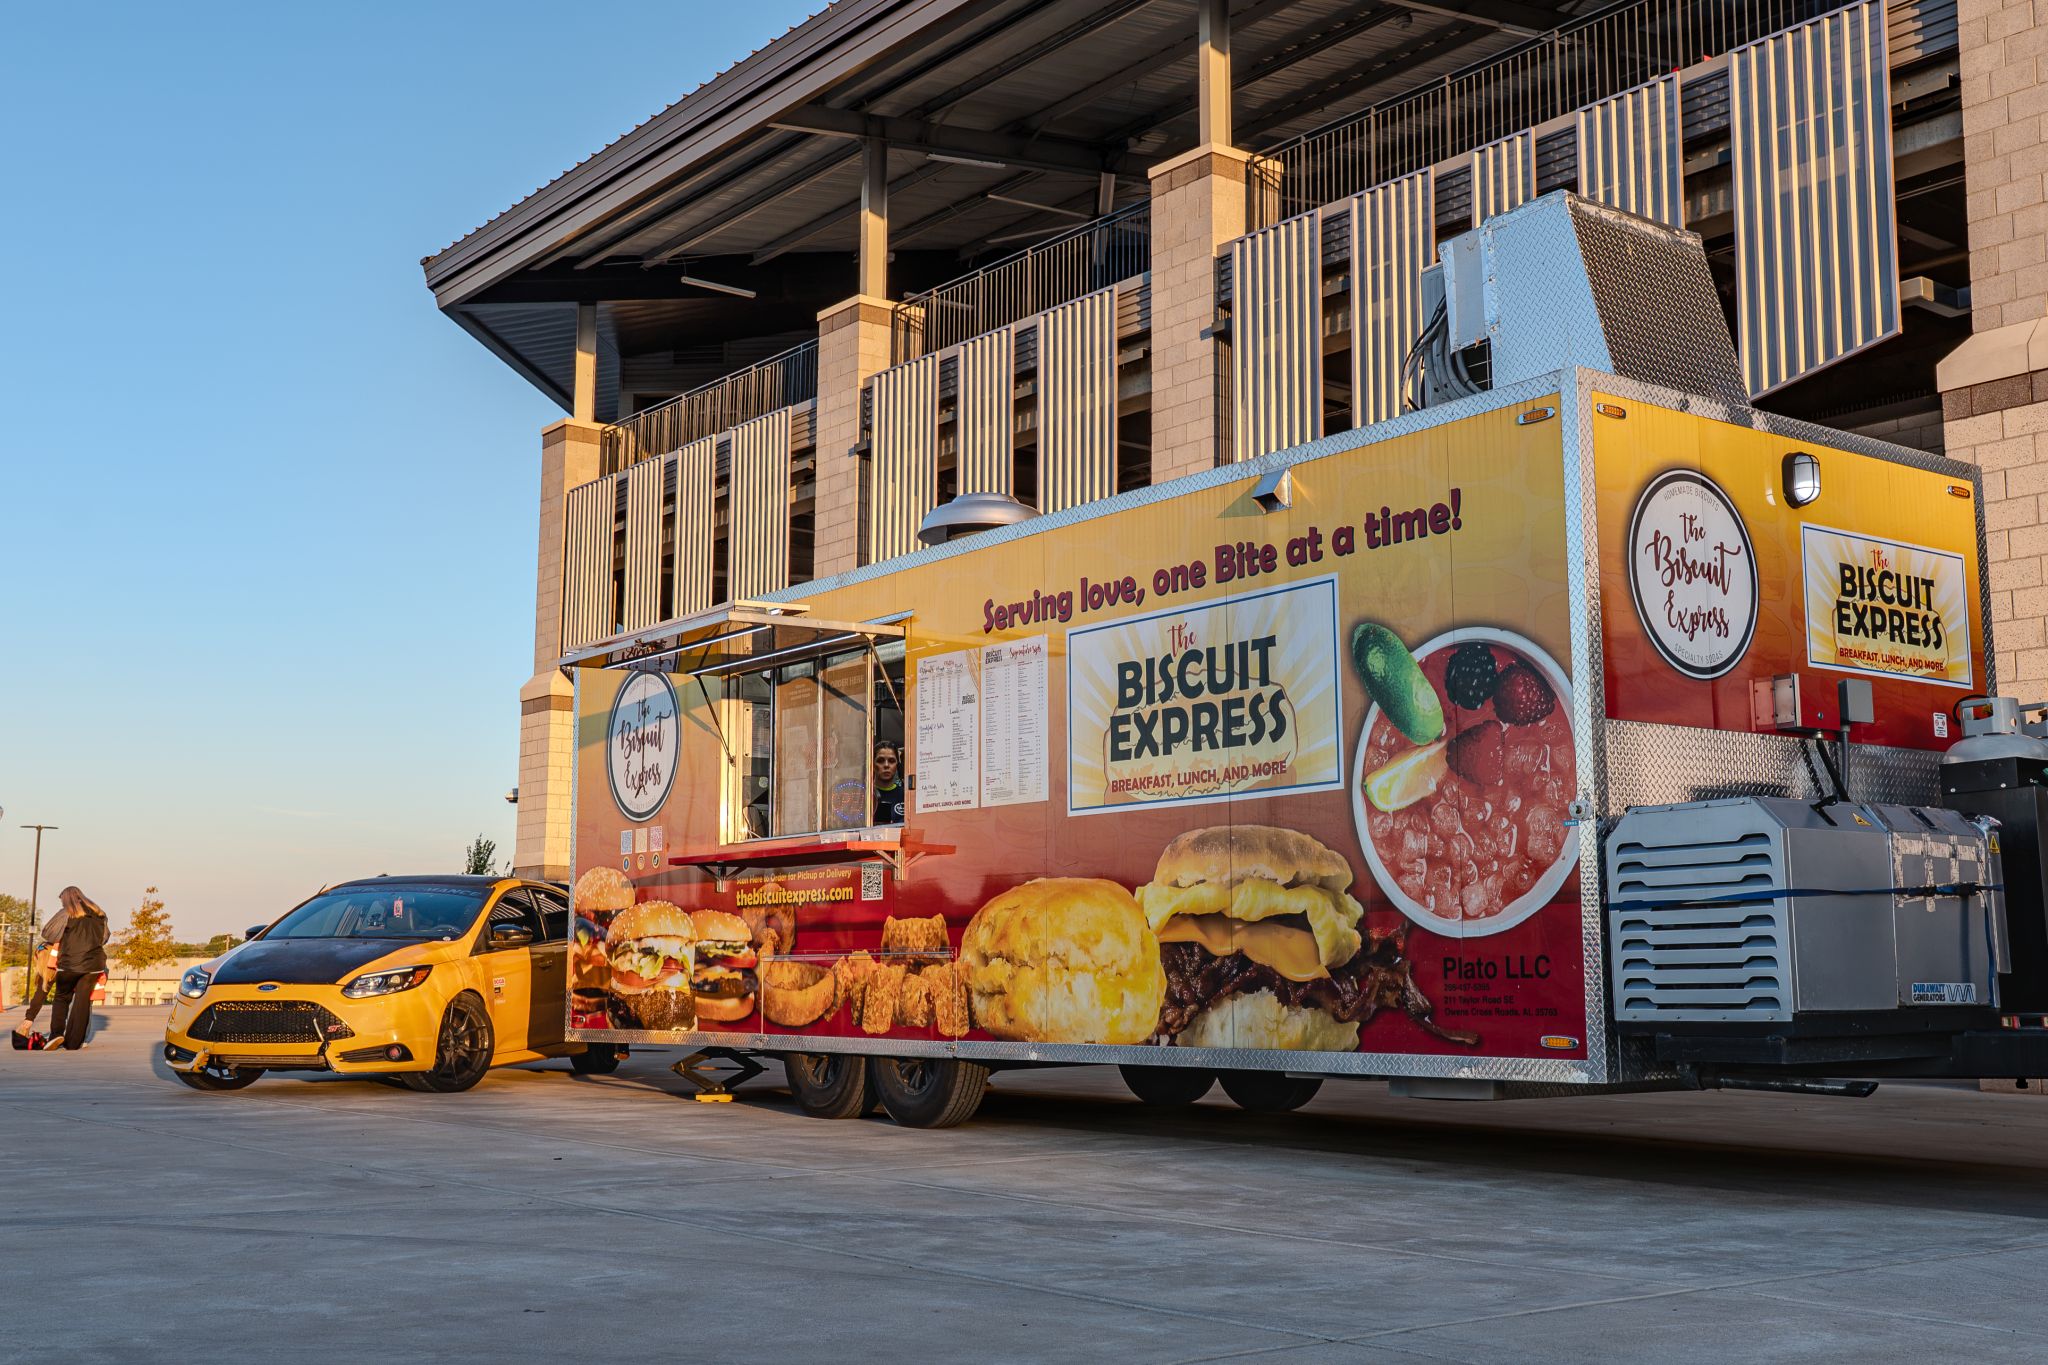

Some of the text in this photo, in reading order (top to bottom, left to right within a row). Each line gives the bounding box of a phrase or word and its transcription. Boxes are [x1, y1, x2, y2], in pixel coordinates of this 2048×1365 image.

[1663, 485, 1720, 512] HOMEMADE BISCUITS
[1679, 512, 1706, 544] the
[983, 488, 1462, 634] Serving love, one Bite at a time!
[1645, 529, 1741, 596] Biscuit
[1870, 549, 1889, 572] the
[1839, 562, 1935, 611] BISCUIT
[1664, 589, 1730, 642] Express
[1836, 600, 1942, 650] EXPRESS
[1167, 622, 1197, 657] the
[1117, 635, 1276, 709] BISCUIT
[1839, 647, 1944, 671] BREAKFAST, LUNCH, AND MORE
[616, 709, 672, 759] Biscuit
[1110, 689, 1287, 762] EXPRESS
[1111, 760, 1287, 792] BREAKFAST, LUNCH, AND MORE
[797, 870, 818, 881] Pickup
[826, 869, 852, 879] Delivery
[736, 886, 854, 907] thebiscuitexpress.com
[1442, 954, 1550, 980] Plato LLC
